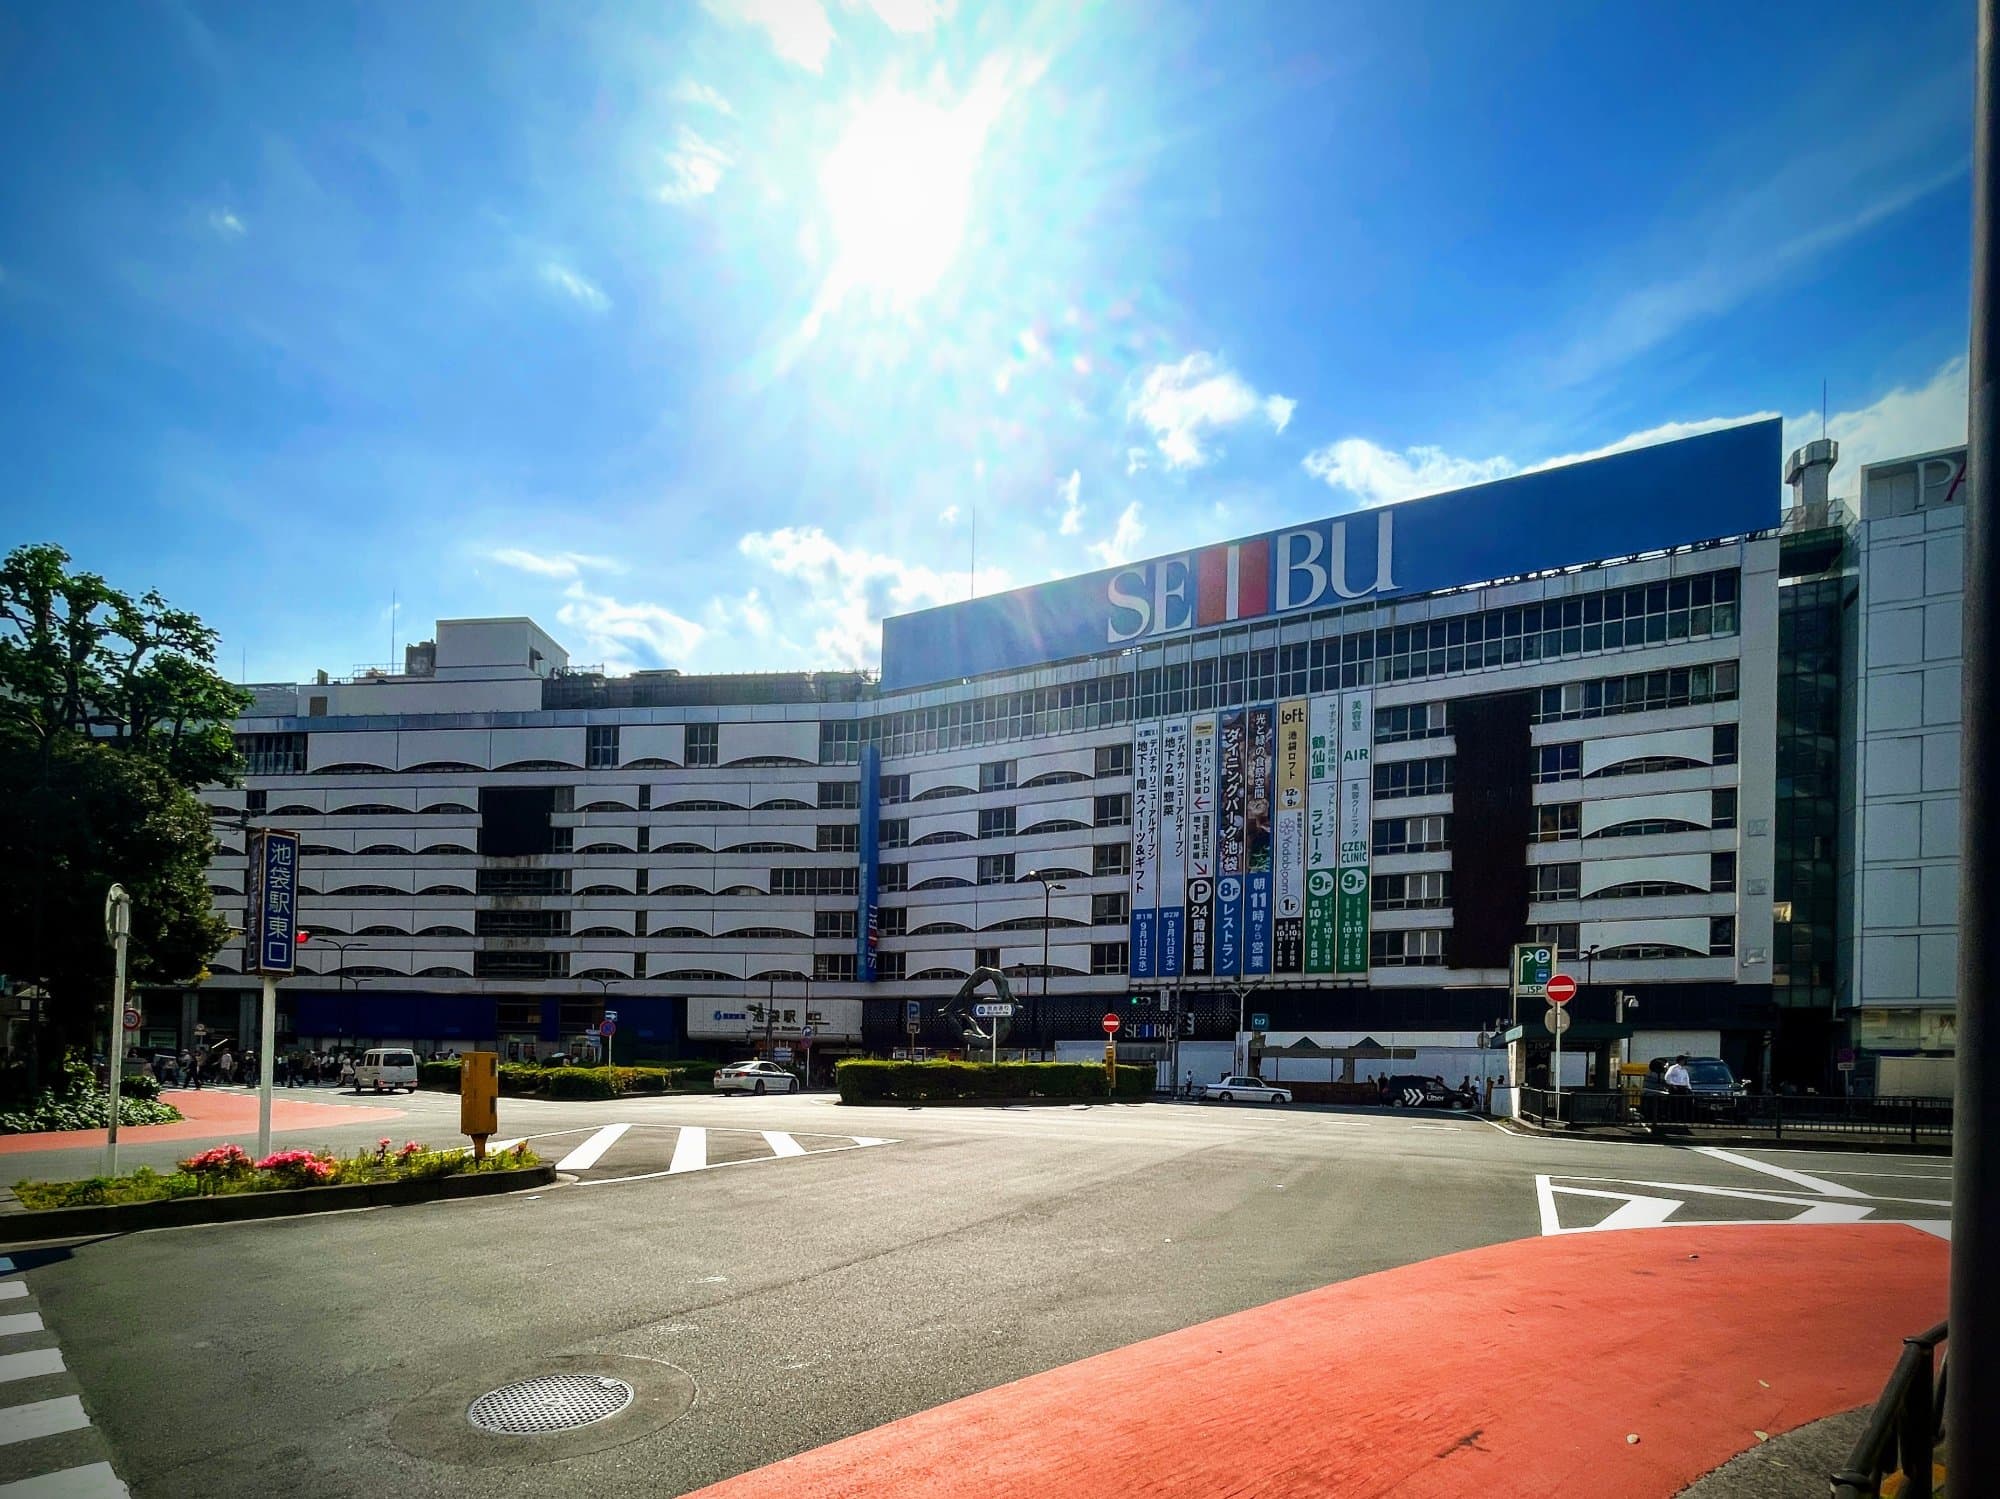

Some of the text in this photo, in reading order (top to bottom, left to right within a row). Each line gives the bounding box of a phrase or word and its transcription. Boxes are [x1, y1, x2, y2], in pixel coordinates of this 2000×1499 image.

[1107, 510, 1404, 644] SEIBU
[1288, 730, 1298, 780] 池袋ロフト
[1343, 748, 1369, 762] AIR
[1222, 727, 1242, 873] ダイニングパーク池袋
[1310, 809, 1323, 865] ラビータ
[1341, 840, 1367, 853] CZEN
[1341, 851, 1367, 864] CLINIC
[1220, 882, 1239, 897] 8F
[1311, 875, 1333, 891] 9F
[1343, 873, 1365, 889] 9F
[267, 842, 292, 962] 池袋駅東口
[1283, 898, 1296, 911] 1F
[1191, 905, 1209, 971] 24時間営業
[1222, 903, 1235, 970] レストラン
[1250, 877, 1267, 968] 朝11時から営業
[1124, 1023, 1173, 1039] SEIBU
